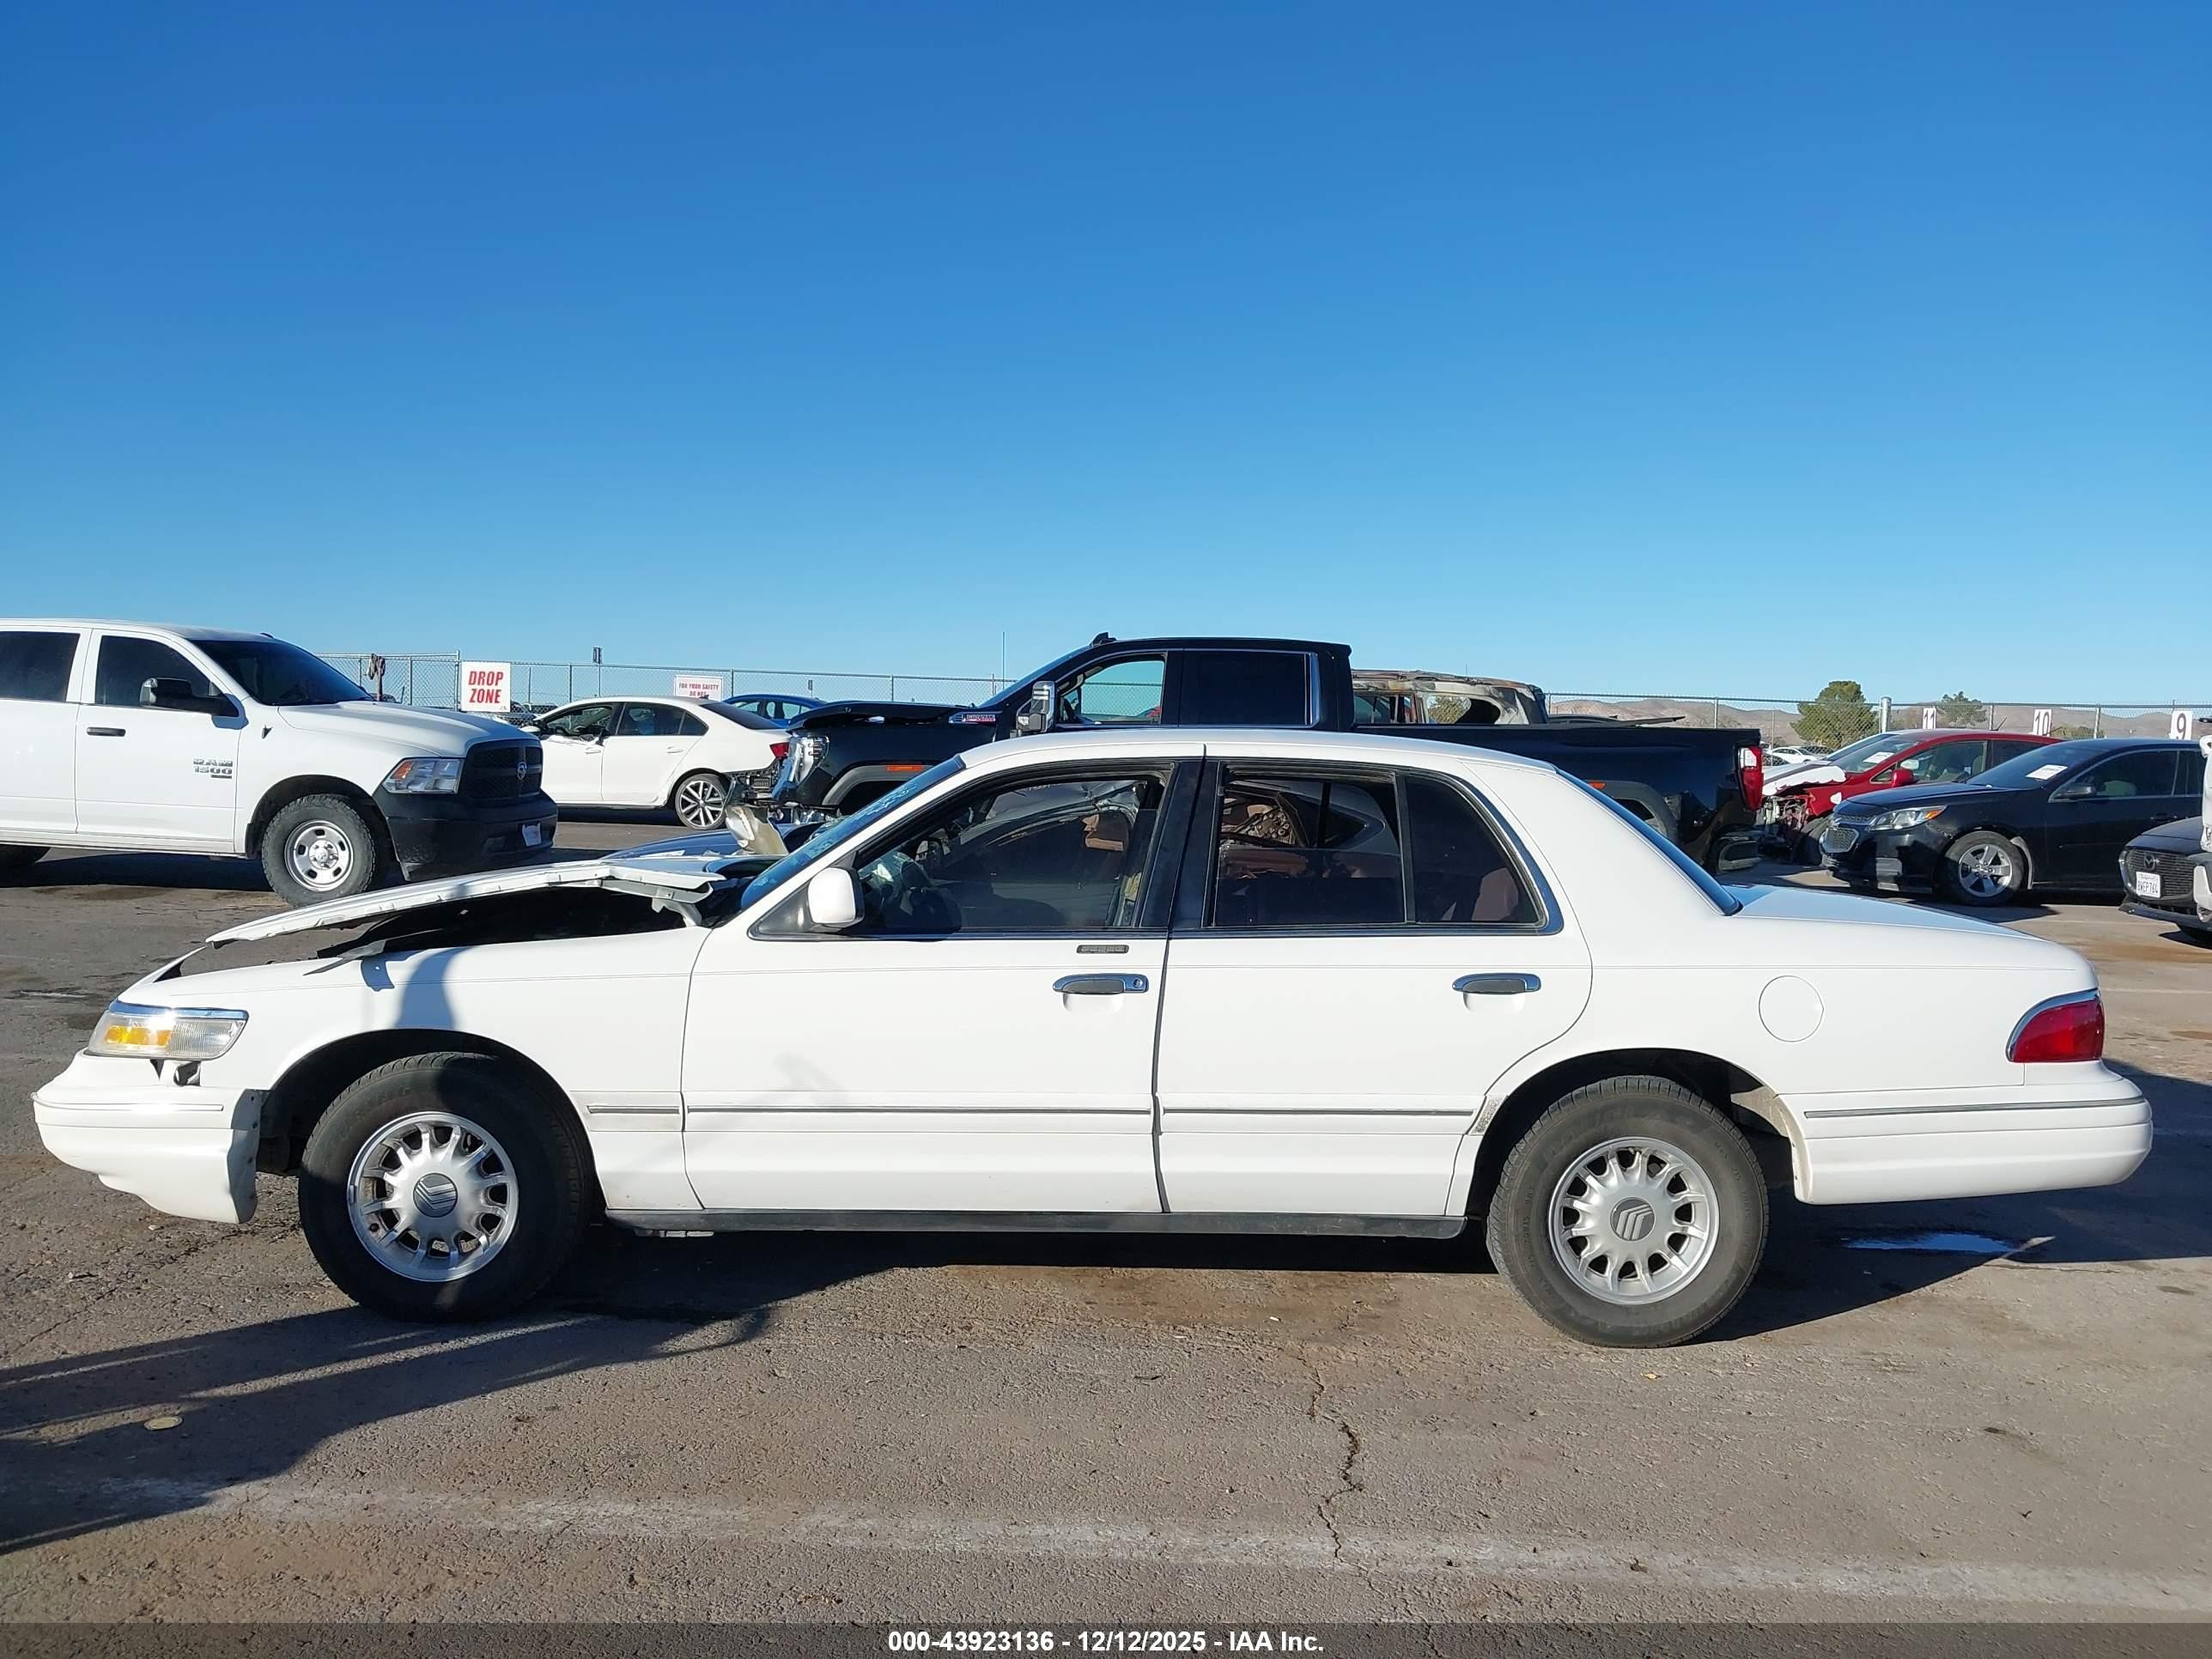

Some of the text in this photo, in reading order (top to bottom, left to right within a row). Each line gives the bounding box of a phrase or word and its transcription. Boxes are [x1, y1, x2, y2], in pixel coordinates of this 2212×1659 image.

[468, 671, 504, 686] DROP
[469, 688, 501, 703] ZONE
[1923, 709, 1935, 729] 11
[2034, 710, 2050, 736] 10
[2176, 713, 2187, 740] 9
[192, 758, 234, 768] RAM
[194, 766, 233, 775] 1500
